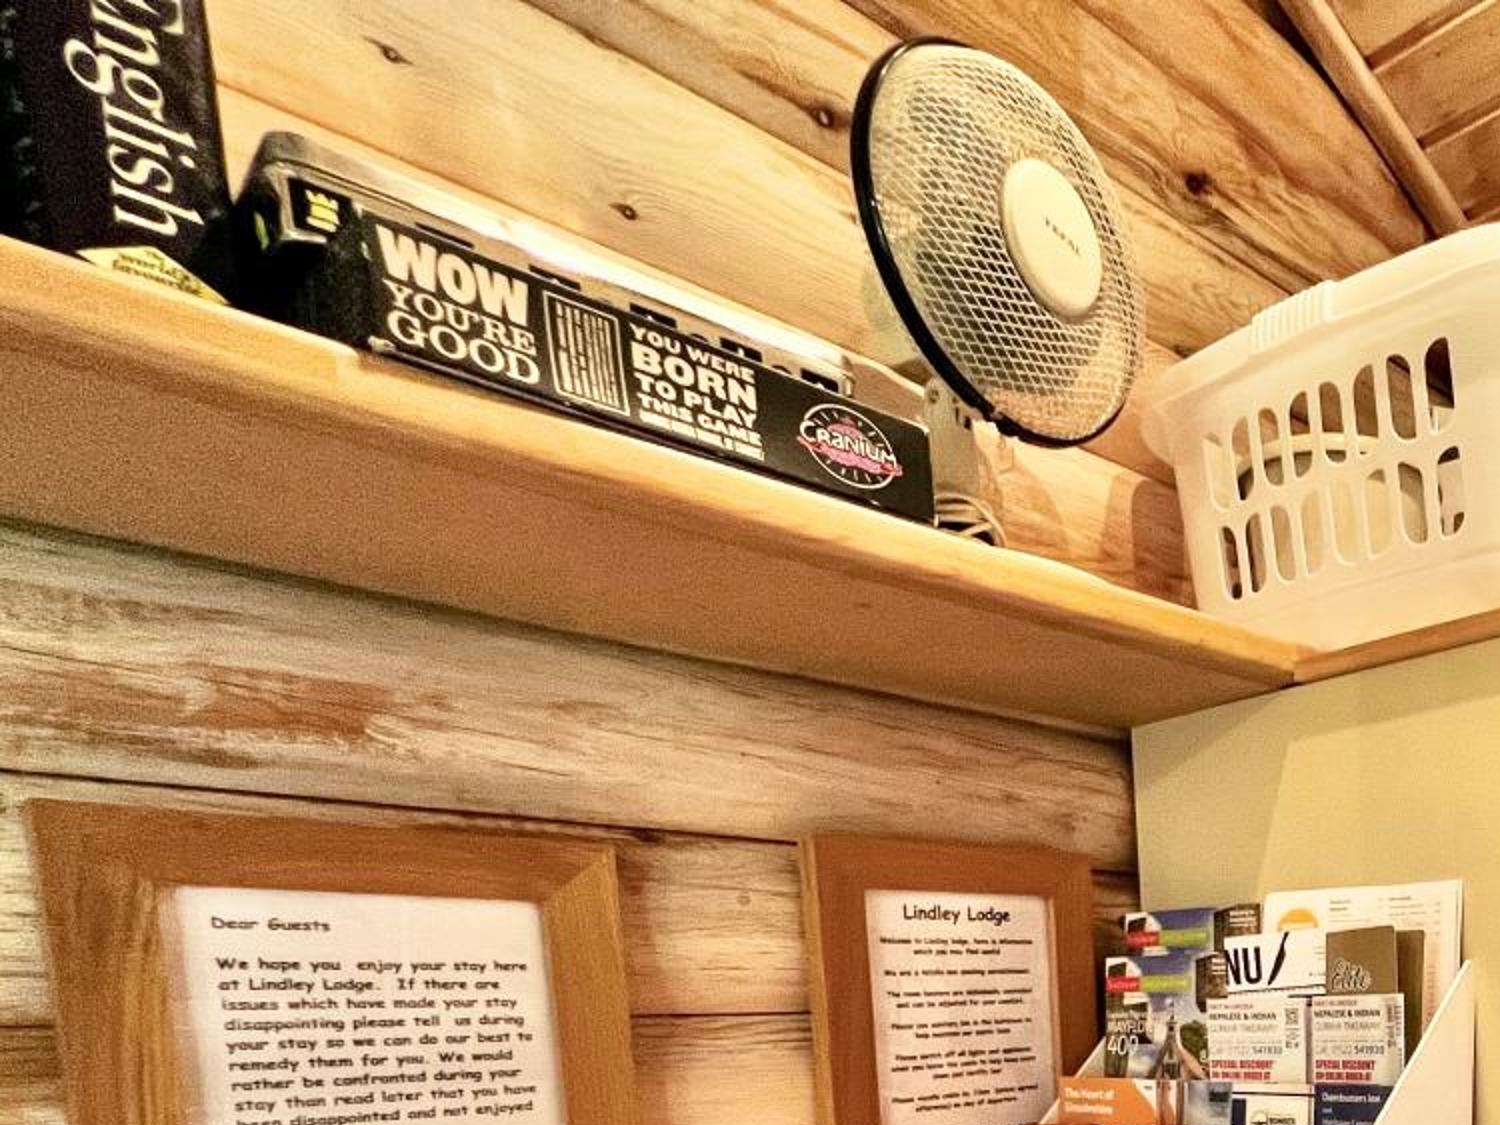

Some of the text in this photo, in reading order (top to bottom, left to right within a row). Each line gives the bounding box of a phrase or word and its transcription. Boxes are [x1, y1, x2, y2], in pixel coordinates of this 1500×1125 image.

[375, 224, 529, 326] WOW
[383, 278, 537, 356] YOU'RE
[387, 310, 539, 385] GOOD
[630, 322, 755, 384] YOU WERE
[630, 341, 757, 412] BORN
[634, 371, 756, 428] TO PLAY
[637, 392, 692, 421] THIS
[698, 412, 762, 448] GAME
[211, 916, 331, 932] Dear Guests
[903, 904, 1011, 926] Lindley Lodge
[216, 958, 527, 974] We hope you enjoy your stay here
[218, 978, 499, 993] at Lindley Lodge. If there are
[221, 997, 518, 1012] issues which have made your stay
[224, 1014, 524, 1033] disappointing please tell us during
[226, 1031, 532, 1055] your stay so we can do our best to
[228, 1050, 512, 1072] remedy them for you. We would
[231, 1067, 522, 1092] rather be confronted during your
[235, 1084, 536, 1113] stay than read later that you have
[407, 1107, 436, 1119] and
[443, 1106, 468, 1117] not
[476, 1101, 533, 1117] enjoyed
